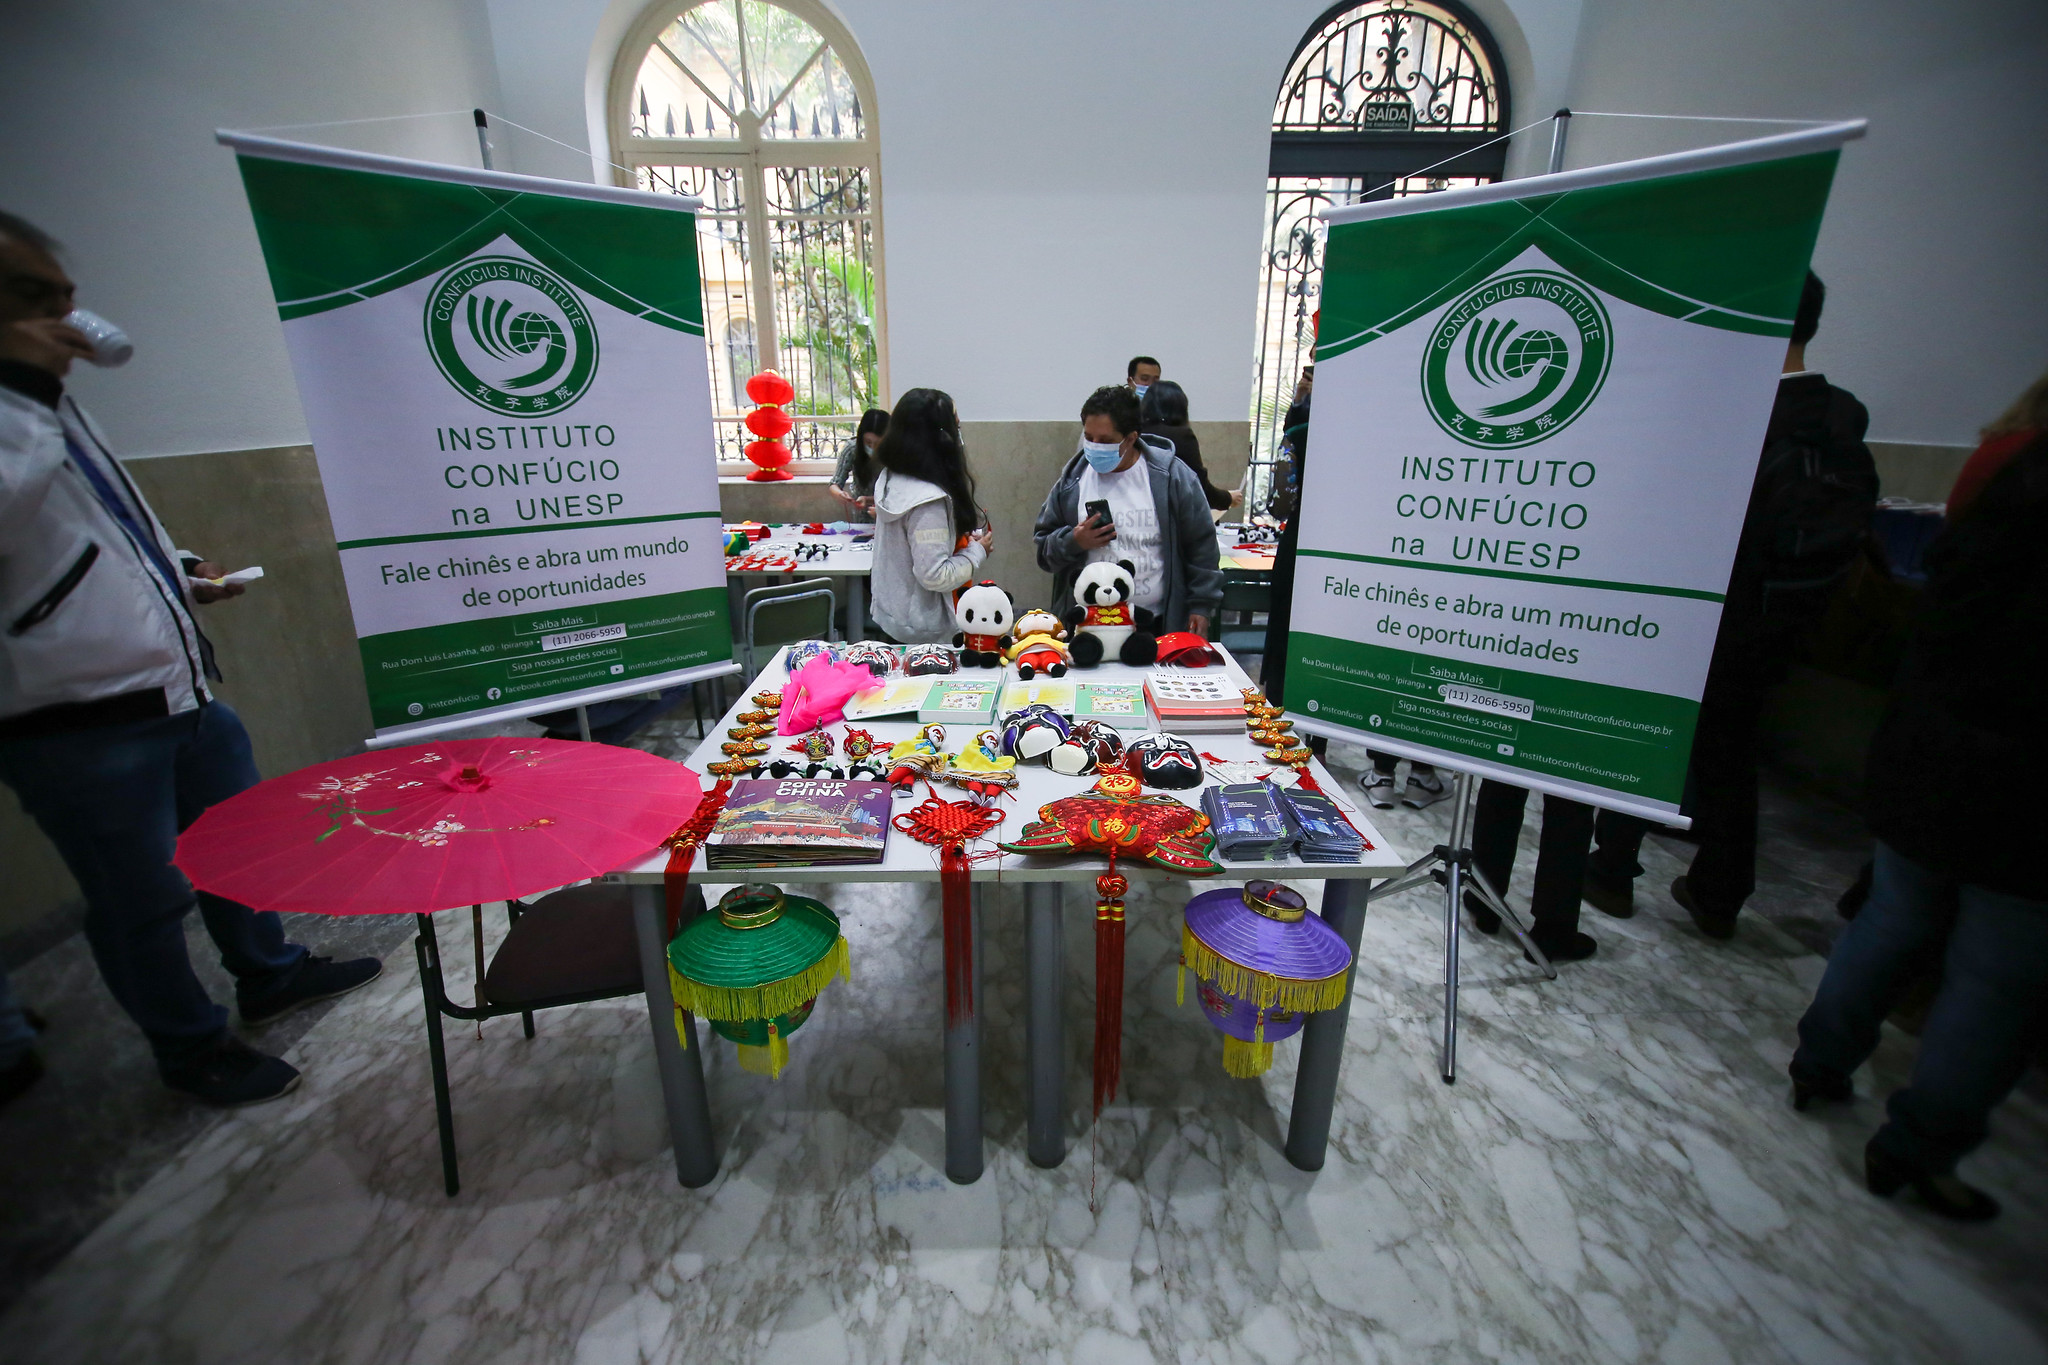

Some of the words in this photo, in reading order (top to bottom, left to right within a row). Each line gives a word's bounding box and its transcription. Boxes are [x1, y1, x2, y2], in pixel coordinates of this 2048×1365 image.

[1366, 104, 1408, 121] SAÍDA
[436, 265, 509, 321] CONFUCIUS
[516, 267, 584, 327] INSTITUTE
[1438, 281, 1526, 350] CONFUCIUS
[1531, 281, 1600, 343] INSTITUTE
[476, 385, 572, 409] 孔子学院
[437, 425, 616, 451] INSTITUTO
[1451, 414, 1558, 440] 孔子学院
[444, 457, 620, 489] CONFÚCIO
[1401, 456, 1596, 488] INSTITUTO
[451, 506, 490, 526] na
[516, 493, 624, 521] UNESP
[1396, 494, 1588, 530] CONFÚCIO
[380, 562, 432, 586] Fale
[437, 554, 512, 579] chinês
[517, 556, 530, 570] e
[536, 548, 582, 568] abra
[587, 546, 618, 563] um
[624, 536, 689, 560] mundo
[1391, 536, 1425, 556] na
[1452, 536, 1580, 570] UNESP
[462, 588, 491, 608] de
[498, 570, 646, 606] oportunidades
[532, 620, 560, 630] Saiba
[561, 616, 584, 626] Mais
[1324, 576, 1360, 598] Fale
[1365, 582, 1429, 609] chinês
[1435, 596, 1448, 611] e
[1453, 594, 1504, 619] abra
[1511, 606, 1551, 626] um
[1558, 610, 1660, 639] mundo
[552, 635, 572, 646] (11)
[574, 626, 622, 642] 2066-5950
[1376, 615, 1402, 636] de
[1406, 622, 1579, 664] oportunidades
[382, 662, 400, 670] Rua
[400, 658, 422, 666] Dom
[480, 644, 494, 652] 400
[501, 640, 534, 650] Ipiranga
[511, 662, 532, 672] Siga
[534, 656, 564, 668] nossas
[566, 652, 590, 662] redes
[505, 669, 606, 694] facebook.com/instconfucio
[1302, 656, 1314, 666] Rua
[1315, 660, 1331, 669] Dom
[1376, 672, 1390, 681] 400
[1396, 676, 1426, 690] Ipiranga
[1430, 666, 1456, 680] Saiba
[1459, 672, 1484, 684] Mais
[428, 694, 480, 709] instconfucio
[1322, 703, 1364, 720] instconfucio
[1398, 700, 1417, 712] Siga
[1420, 706, 1450, 719] nossas
[1452, 712, 1480, 726] redes
[1482, 720, 1513, 732] socias
[1448, 688, 1469, 703] (11)
[1472, 694, 1530, 714] 2066-5950
[1385, 719, 1492, 750] facebook.com/instconfucio
[1535, 704, 1673, 736] www.institutoconfucio.unesp.br
[1519, 750, 1641, 784] institutoconfuciounespbr
[775, 788, 846, 797] CHINA
[778, 781, 818, 789] POP
[822, 782, 848, 790] UP
